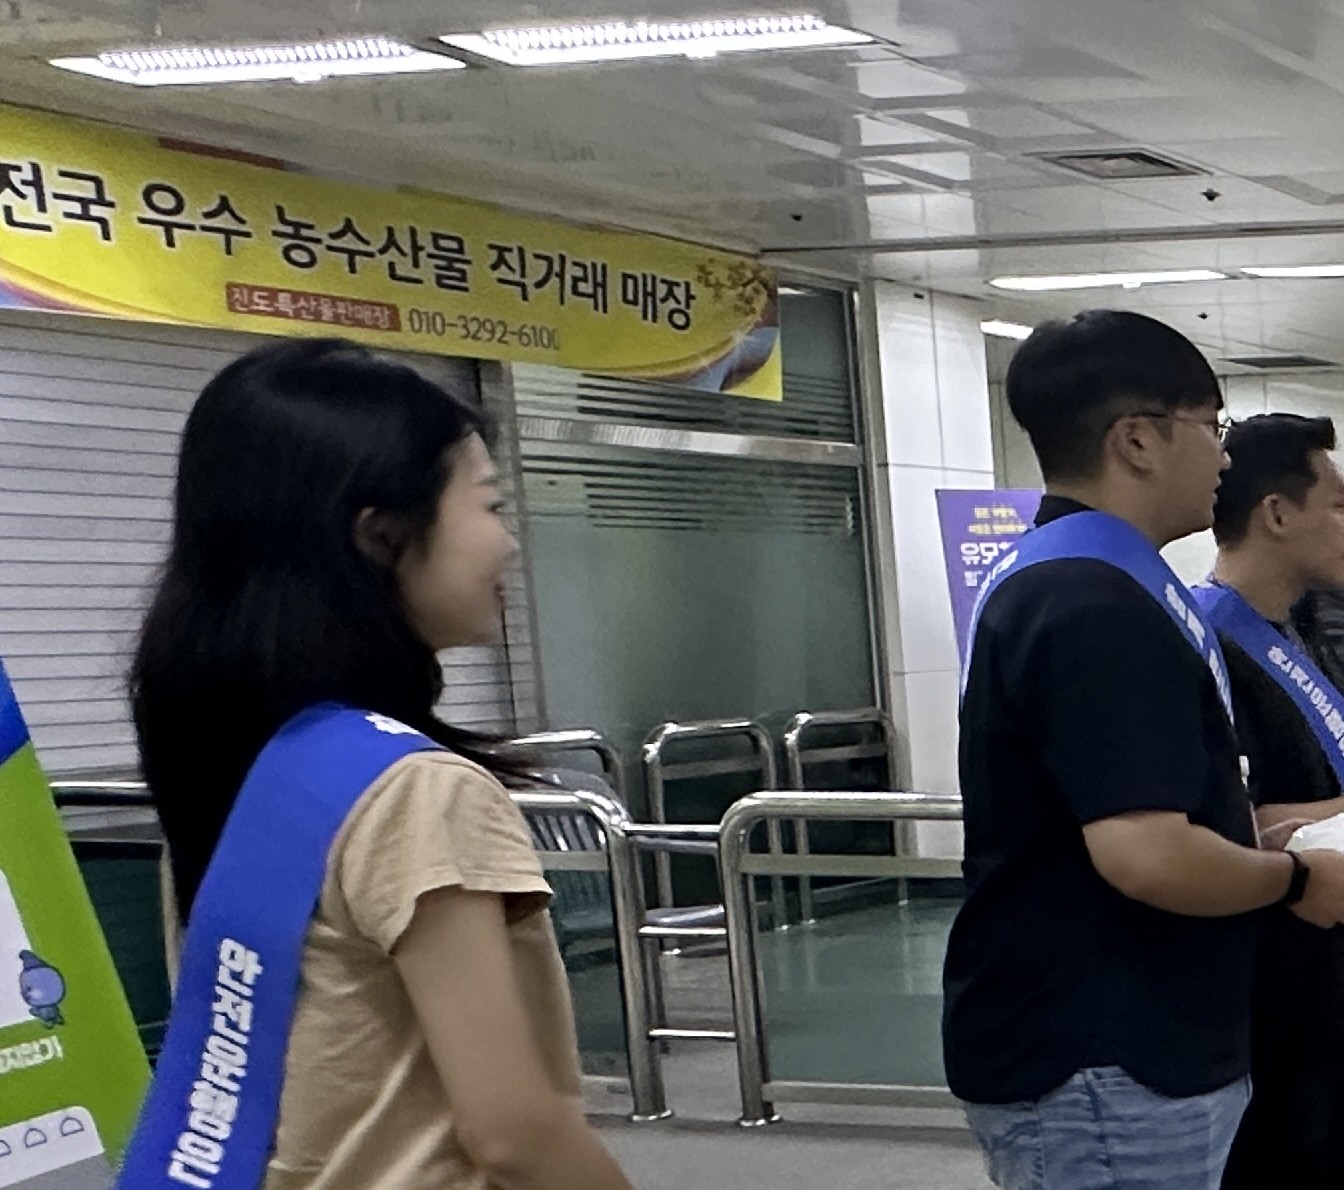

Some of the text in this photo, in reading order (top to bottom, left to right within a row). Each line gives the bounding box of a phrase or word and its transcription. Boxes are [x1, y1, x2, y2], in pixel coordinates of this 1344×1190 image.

[0, 161, 696, 332] 전국 우수 농수산물 직거래 매장
